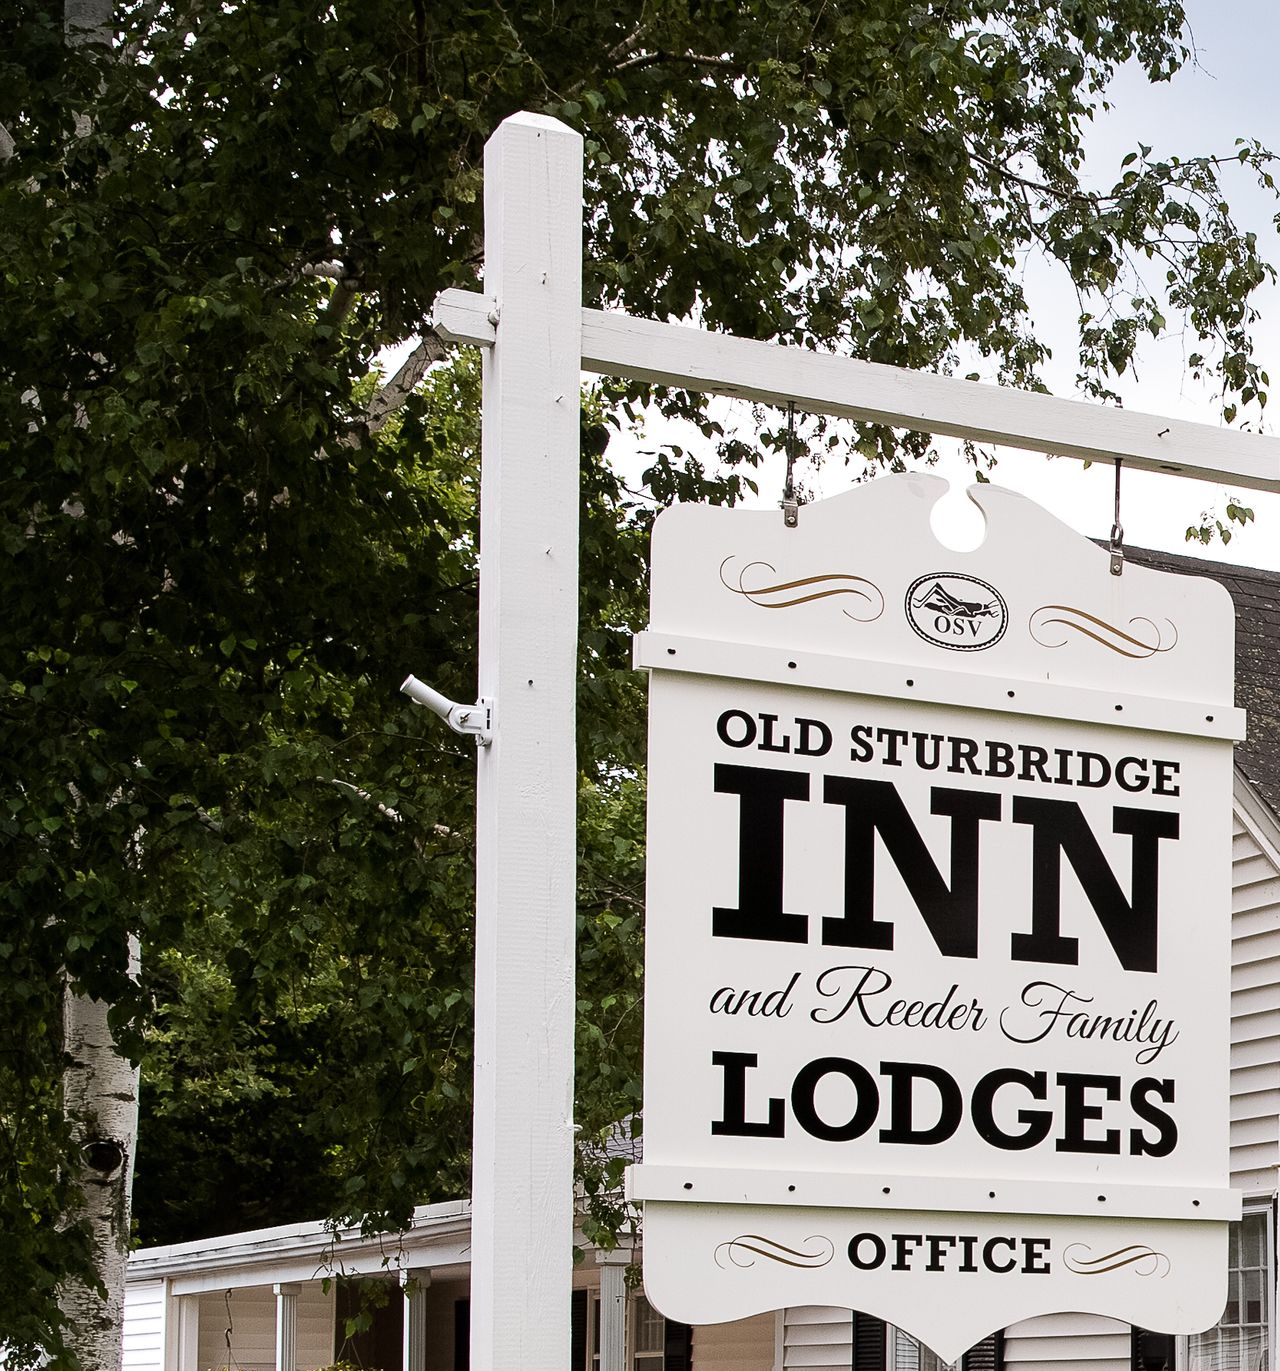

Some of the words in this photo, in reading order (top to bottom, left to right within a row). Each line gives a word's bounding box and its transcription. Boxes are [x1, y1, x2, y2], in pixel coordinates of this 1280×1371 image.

[934, 615, 982, 637] OSV
[716, 709, 833, 757] OLD
[850, 724, 1180, 798] STURBRIDGE
[712, 762, 1180, 974] INN
[708, 973, 802, 1018] and
[809, 965, 988, 1031] Reeder
[1000, 981, 1180, 1065] Family
[711, 1050, 1178, 1158] LODGES
[847, 1232, 1051, 1275] OFFICE
